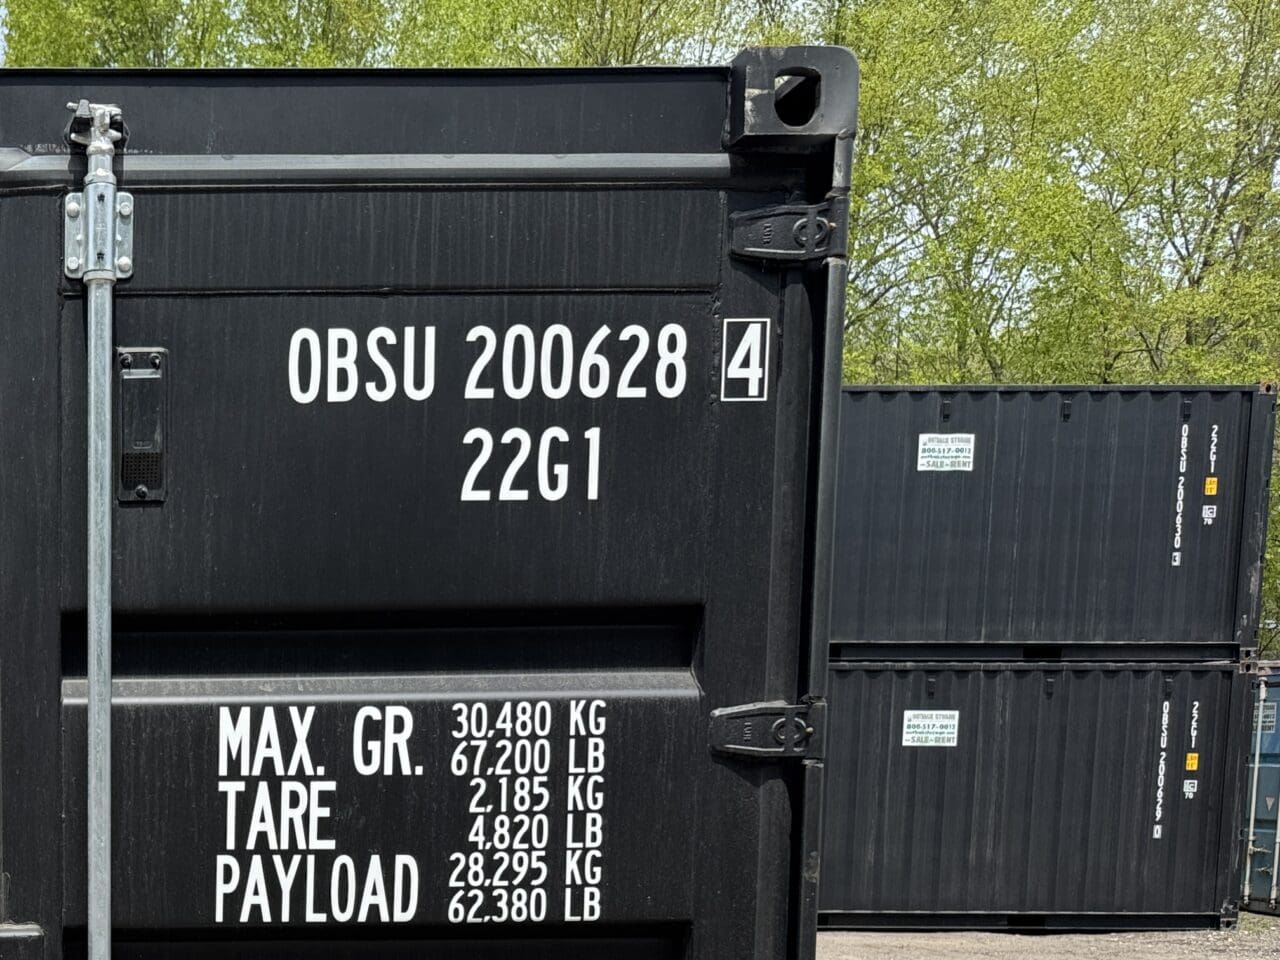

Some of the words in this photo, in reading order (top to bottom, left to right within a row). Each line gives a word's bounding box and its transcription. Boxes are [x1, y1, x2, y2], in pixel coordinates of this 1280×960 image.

[288, 326, 436, 403] OBSU
[464, 323, 687, 400] 200628
[726, 322, 764, 397] 4
[461, 426, 601, 501] 22G1
[1179, 424, 1189, 473] OBSU
[1210, 425, 1218, 473] 22G1
[1174, 476, 1185, 549] 200630
[218, 705, 325, 776] MAX.
[353, 705, 424, 776] GR.
[451, 700, 552, 739] 30,480
[569, 699, 607, 736] KG
[1161, 701, 1169, 749] OBSU
[1191, 701, 1199, 748] 22G1
[450, 738, 551, 776] 67,200
[568, 737, 605, 774] LB
[469, 775, 550, 813] 2,185
[567, 775, 604, 811] KG
[1155, 751, 1167, 822] 200629
[218, 780, 337, 850] TARE
[468, 813, 549, 850] 4,820
[565, 813, 603, 849] LB
[215, 854, 419, 923] PAYLOAD
[448, 850, 548, 888] 28,295
[565, 849, 602, 886] KG
[447, 887, 547, 924] 62,380
[564, 886, 601, 922] LB
